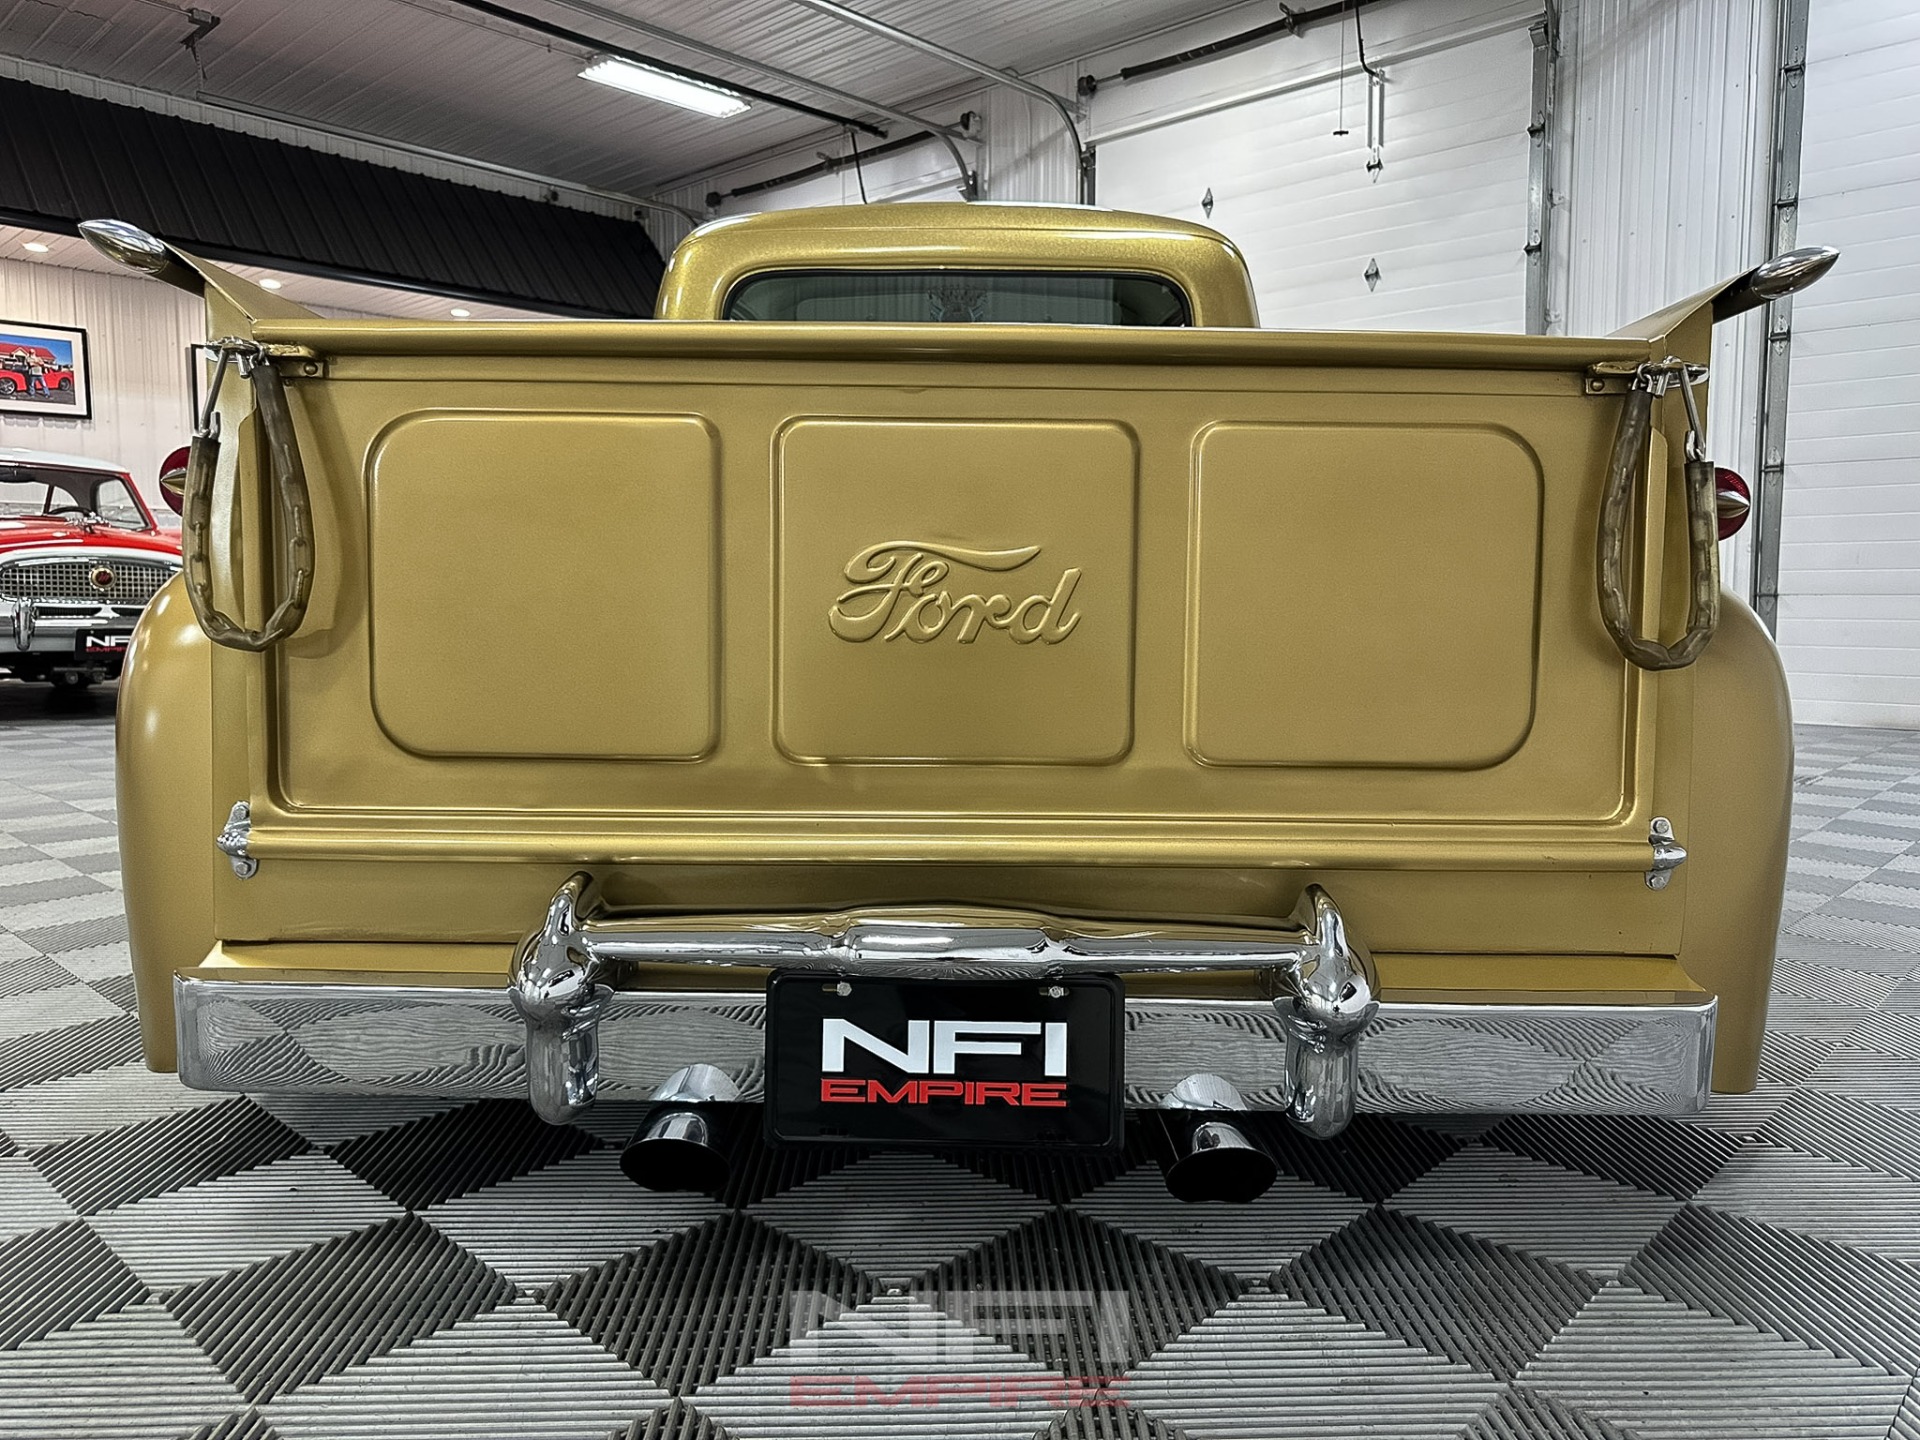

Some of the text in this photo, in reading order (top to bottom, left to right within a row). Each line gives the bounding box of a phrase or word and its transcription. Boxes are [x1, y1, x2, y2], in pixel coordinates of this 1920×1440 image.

[828, 540, 1082, 644] Ford
[86, 635, 131, 646] NF
[821, 1018, 1067, 1076] NFI
[820, 1078, 1067, 1107] EMPIRE
